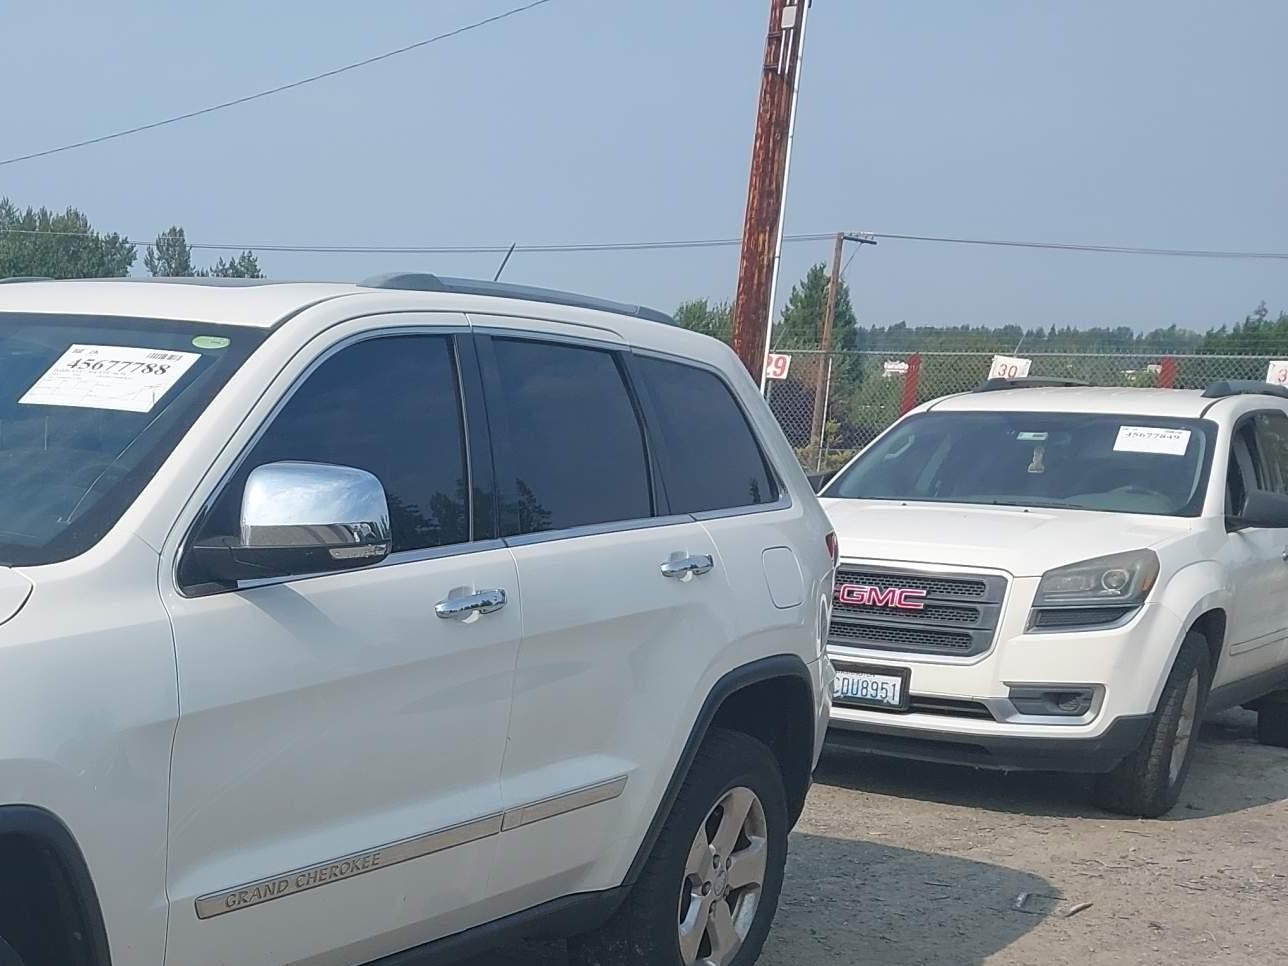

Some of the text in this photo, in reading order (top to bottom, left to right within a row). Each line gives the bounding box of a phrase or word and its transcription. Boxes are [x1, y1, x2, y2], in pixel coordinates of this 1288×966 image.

[67, 358, 172, 376] 45677788
[998, 363, 1018, 378] 30
[839, 583, 927, 609] GMC
[224, 852, 382, 909] GRAND CHEROKEE
